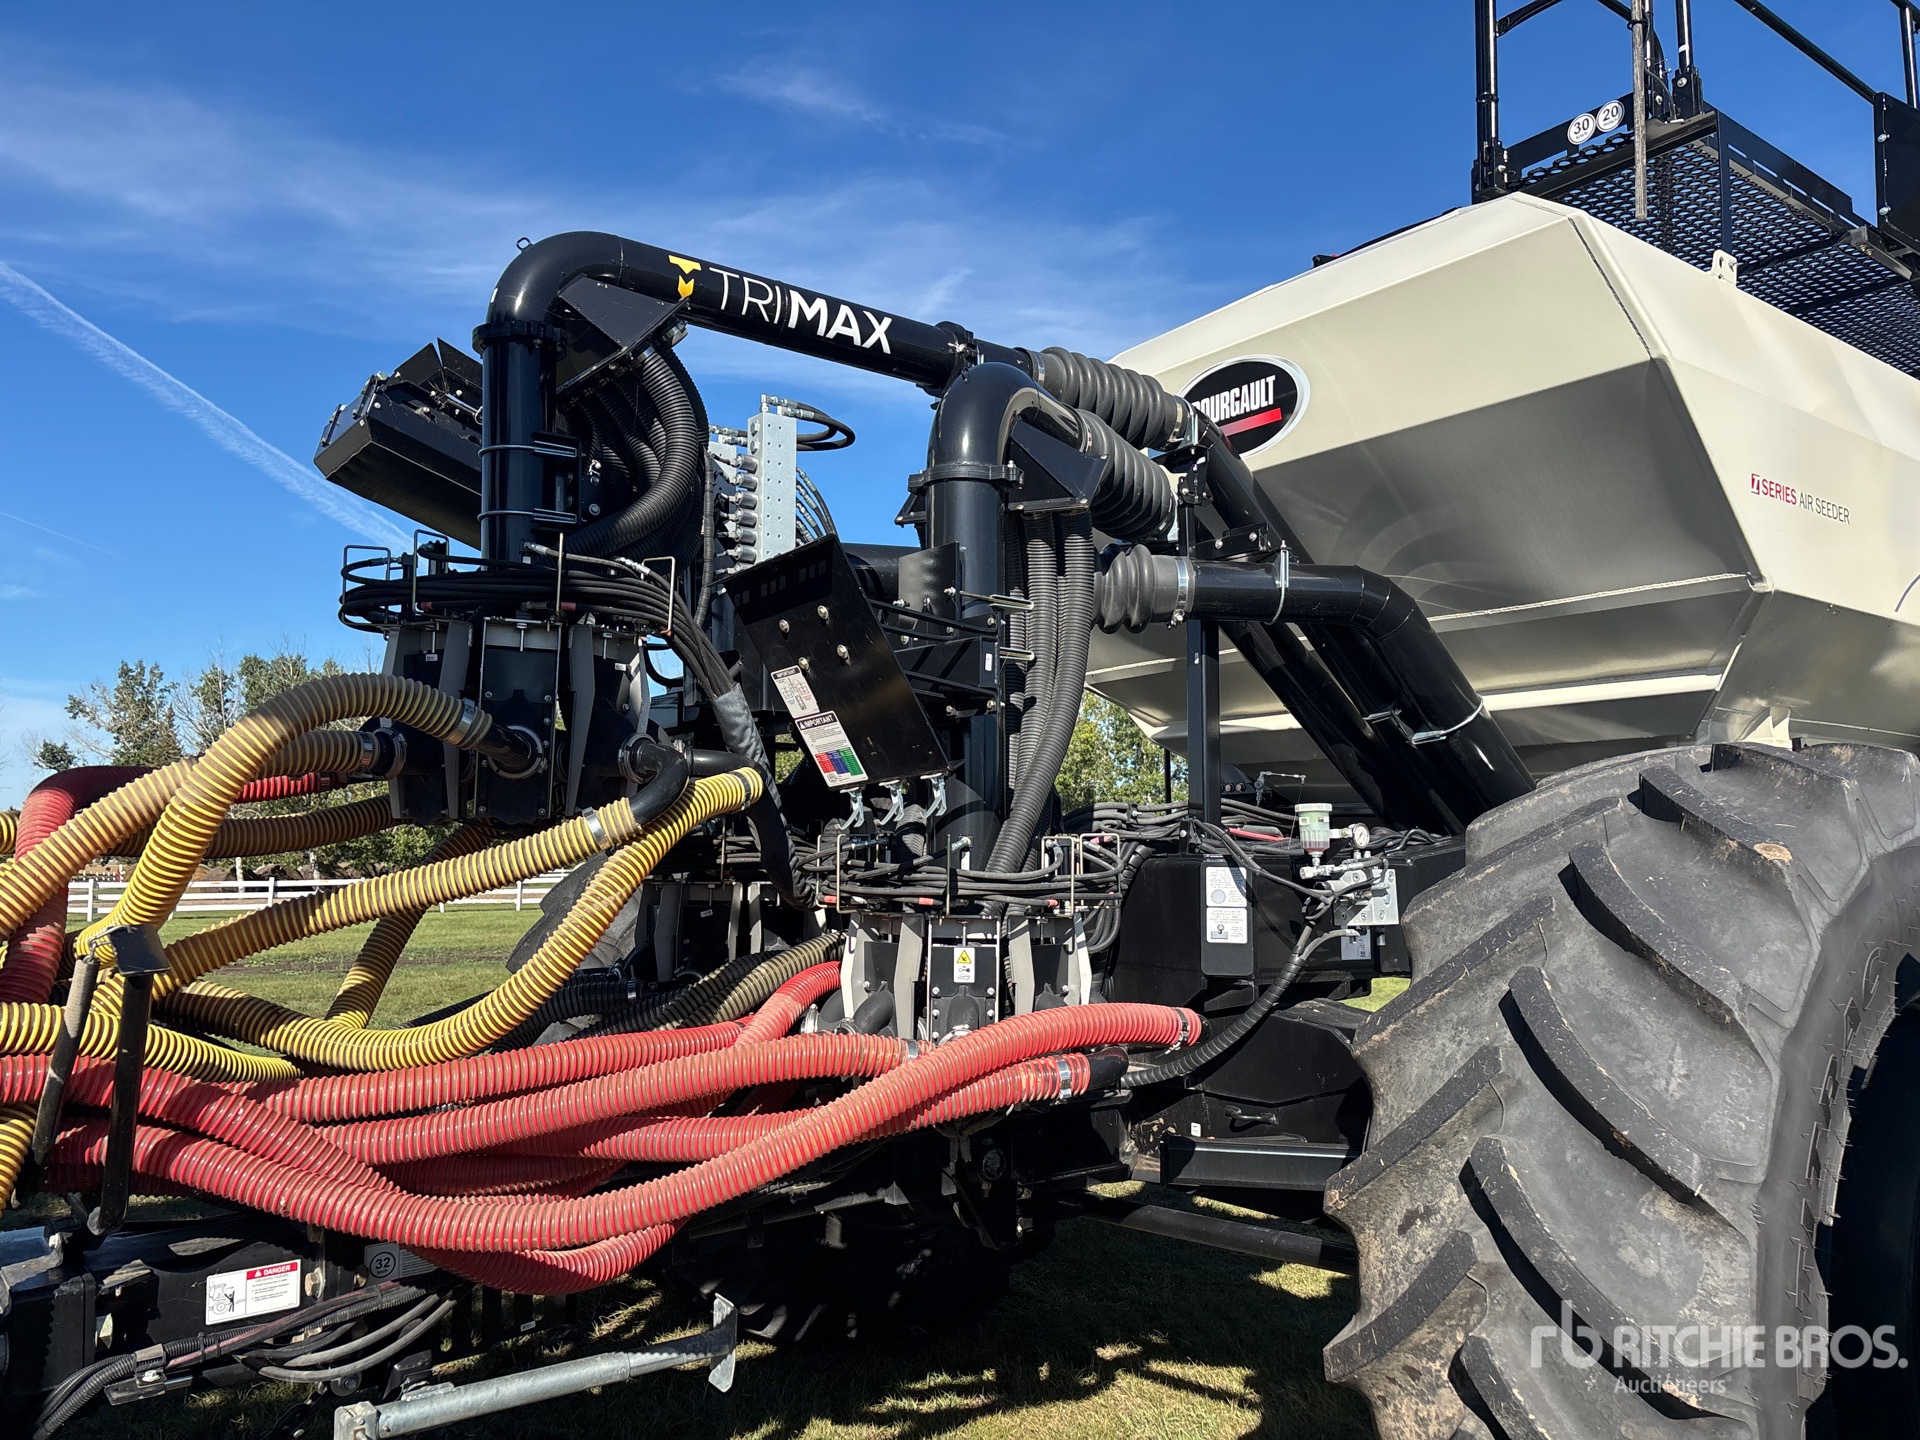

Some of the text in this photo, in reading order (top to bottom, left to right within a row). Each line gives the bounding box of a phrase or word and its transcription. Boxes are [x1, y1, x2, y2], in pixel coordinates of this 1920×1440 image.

[1603, 105, 1619, 121] 20
[1573, 118, 1590, 135] 30
[709, 267, 893, 354] TRIMAX
[1762, 479, 1797, 505] SERIES
[1799, 492, 1814, 512] AIR
[1815, 498, 1850, 524] SEEDER
[804, 714, 834, 728] IMPORTANT
[263, 1265, 291, 1276] DANGER
[375, 1257, 391, 1269] 32
